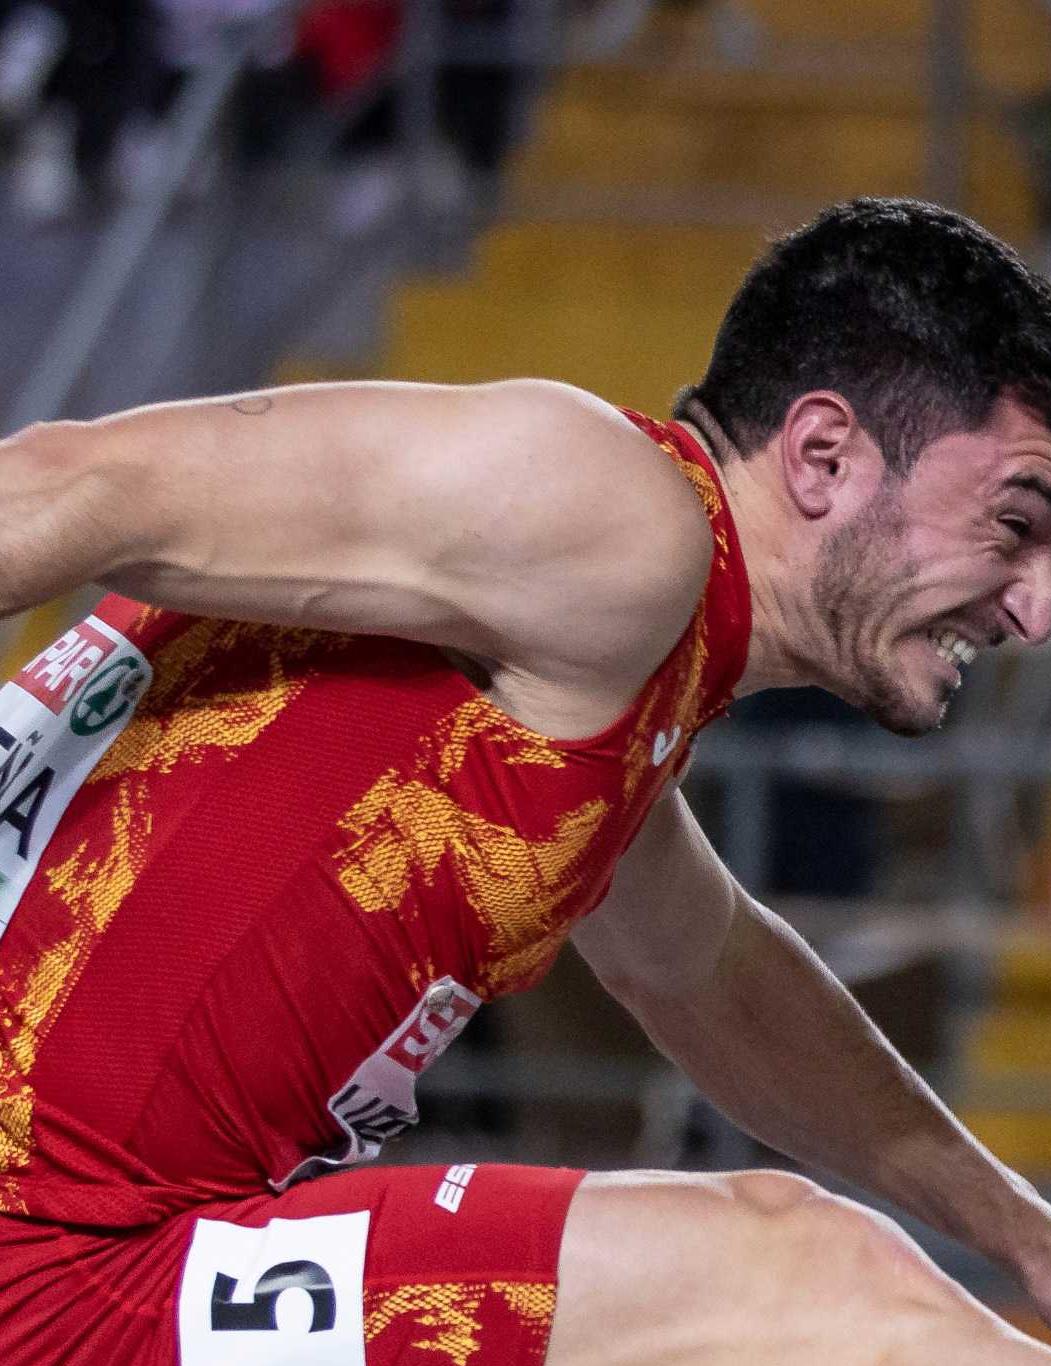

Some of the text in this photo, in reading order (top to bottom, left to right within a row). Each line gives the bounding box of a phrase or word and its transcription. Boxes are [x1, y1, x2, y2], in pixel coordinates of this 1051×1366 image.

[21, 630, 104, 702] PAR
[434, 1163, 479, 1214] ES
[211, 1260, 337, 1334] 5
